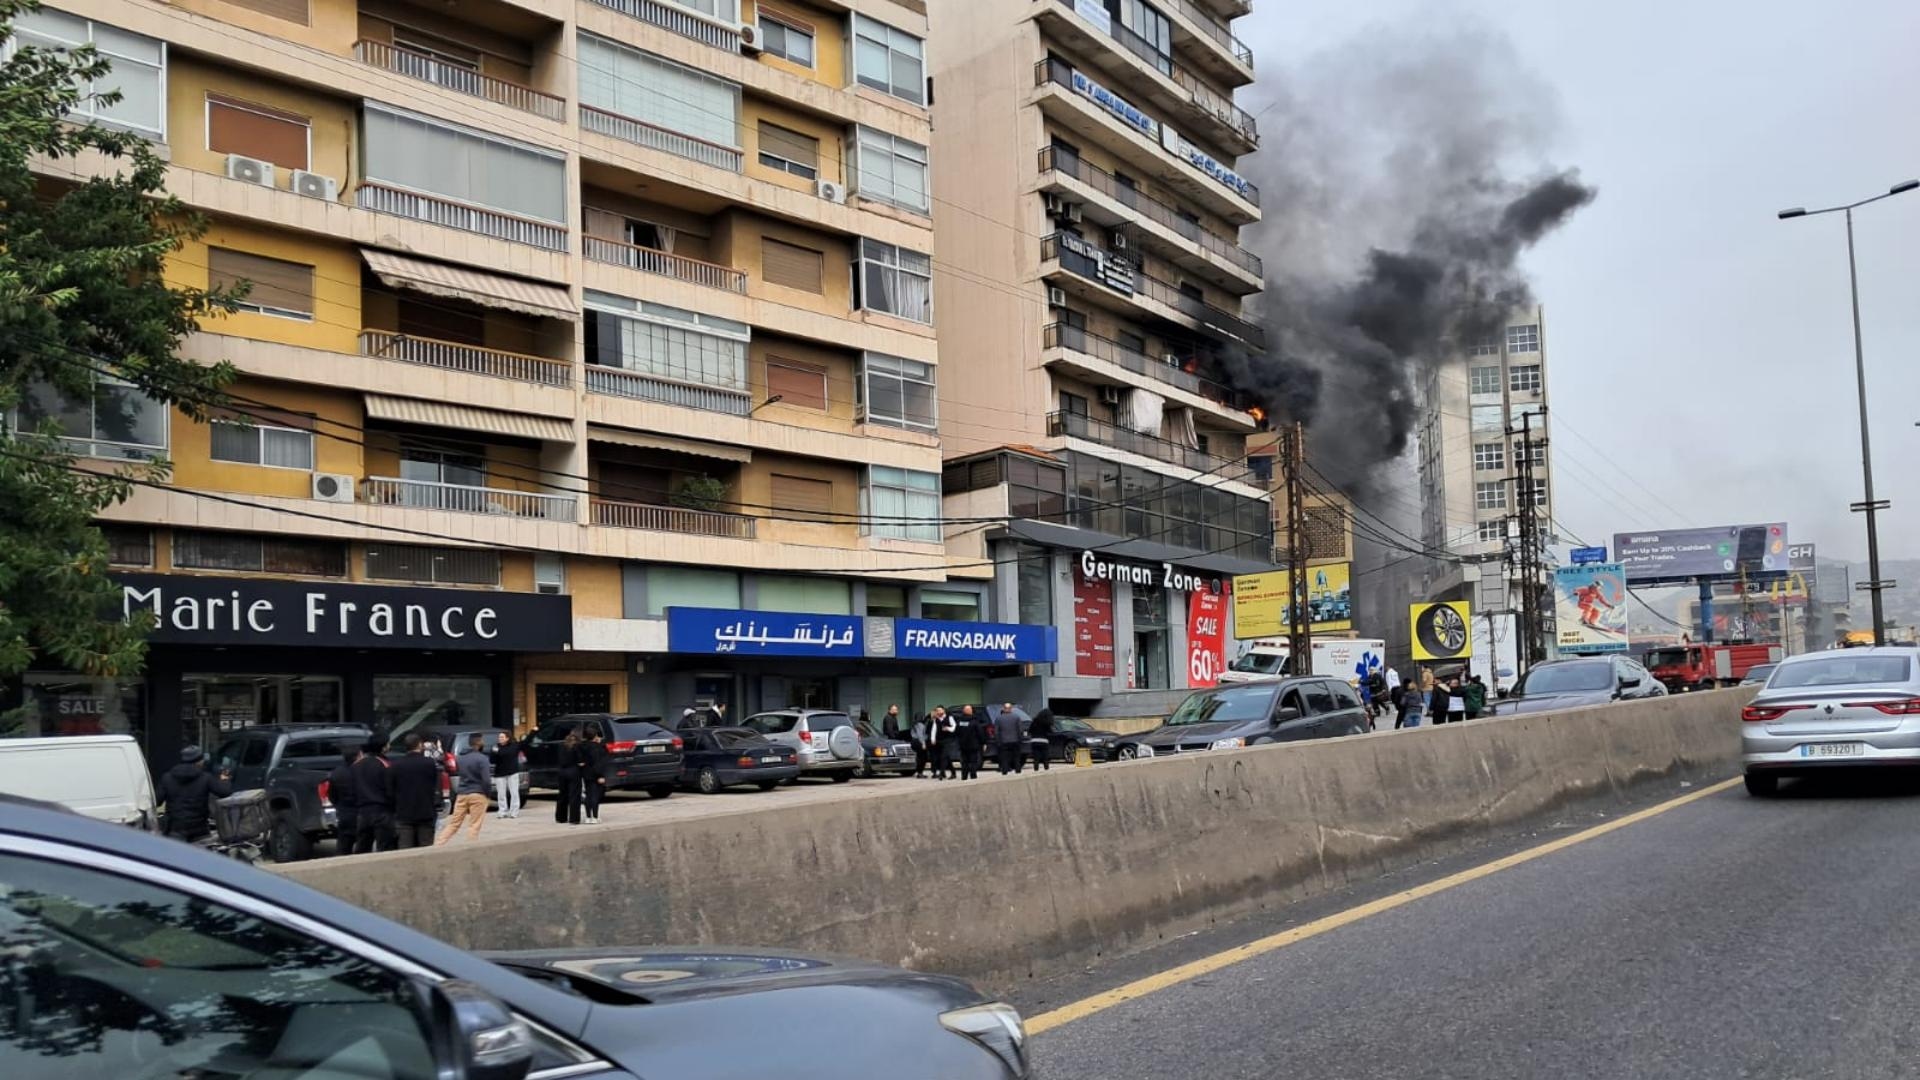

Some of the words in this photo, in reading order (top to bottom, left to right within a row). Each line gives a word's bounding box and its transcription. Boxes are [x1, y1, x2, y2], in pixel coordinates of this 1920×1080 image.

[1081, 550, 1152, 585] German
[1163, 563, 1202, 592] Zone
[123, 586, 275, 632] Marie
[306, 593, 499, 639] France
[1196, 616, 1218, 635] SALE
[905, 630, 1017, 650] FRANSABANK
[58, 700, 105, 714] SALE
